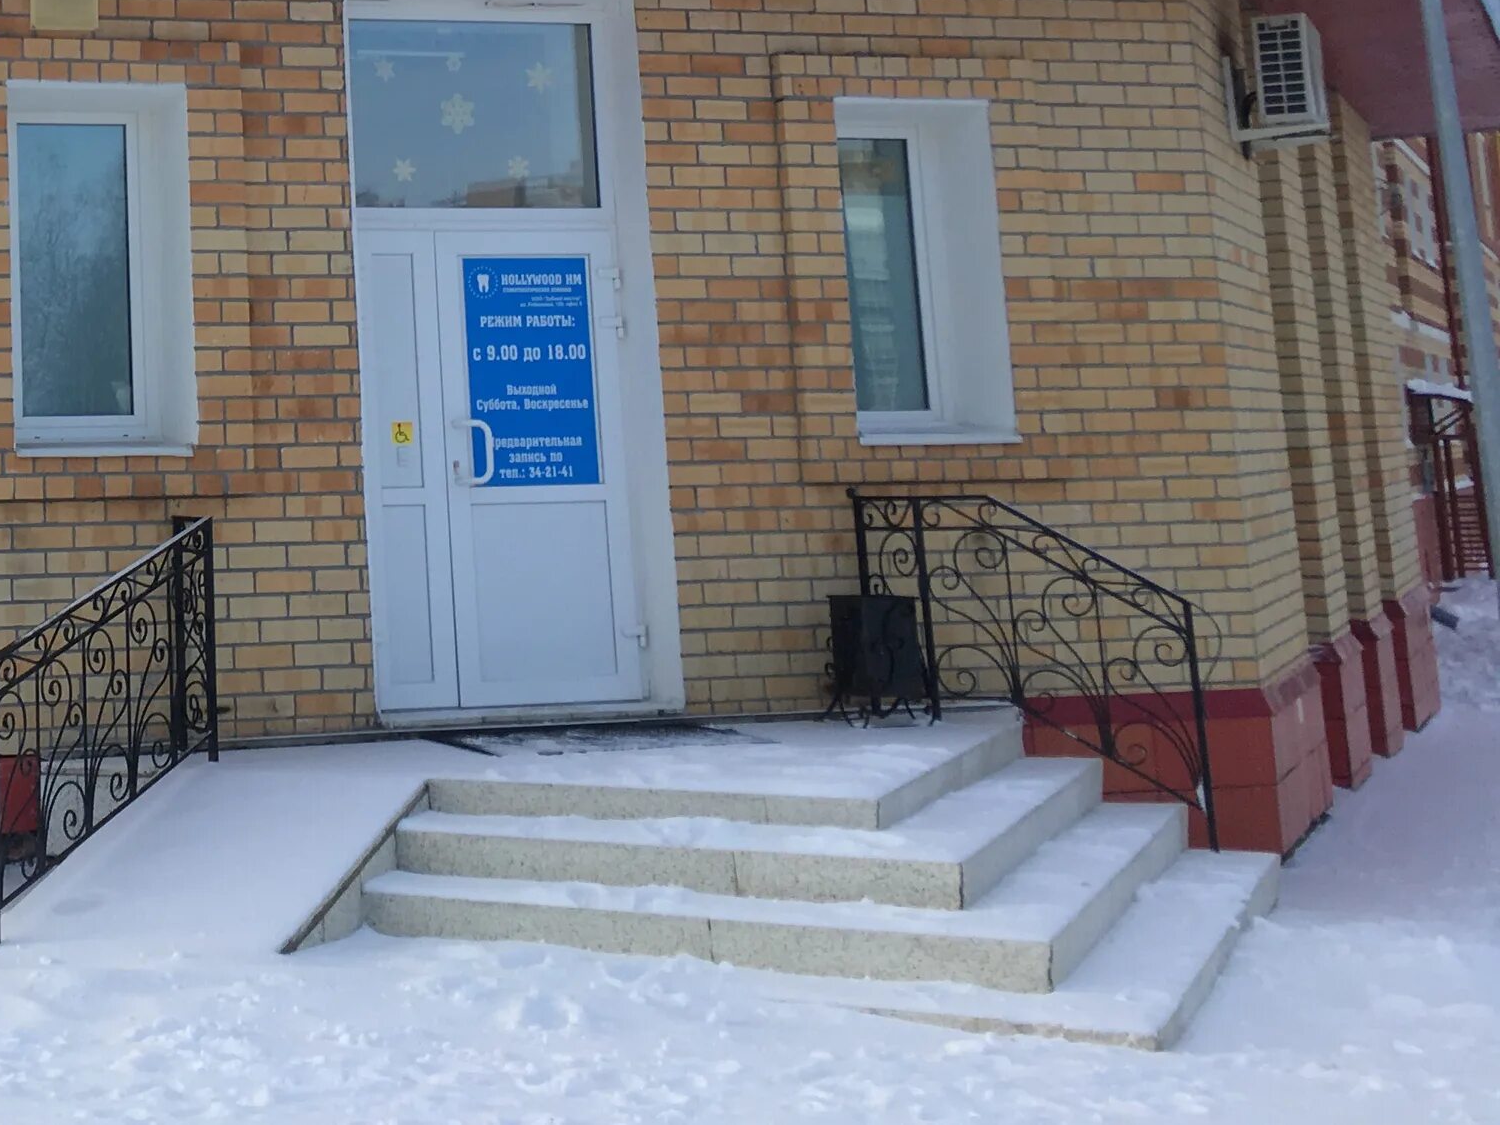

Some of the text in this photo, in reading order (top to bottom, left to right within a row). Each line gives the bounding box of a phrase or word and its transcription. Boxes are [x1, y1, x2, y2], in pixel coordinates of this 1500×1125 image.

[501, 273, 562, 285] HOLLYWOOD
[480, 315, 576, 328] РЕЖИМ РАБОТЫ:
[486, 345, 518, 361] 9.00
[523, 347, 541, 362] до
[547, 344, 586, 360] 18.00
[506, 384, 557, 397] Выходной
[523, 399, 589, 411] Воскресенье
[509, 452, 563, 463] запись по
[529, 466, 573, 478] 34-21-41
